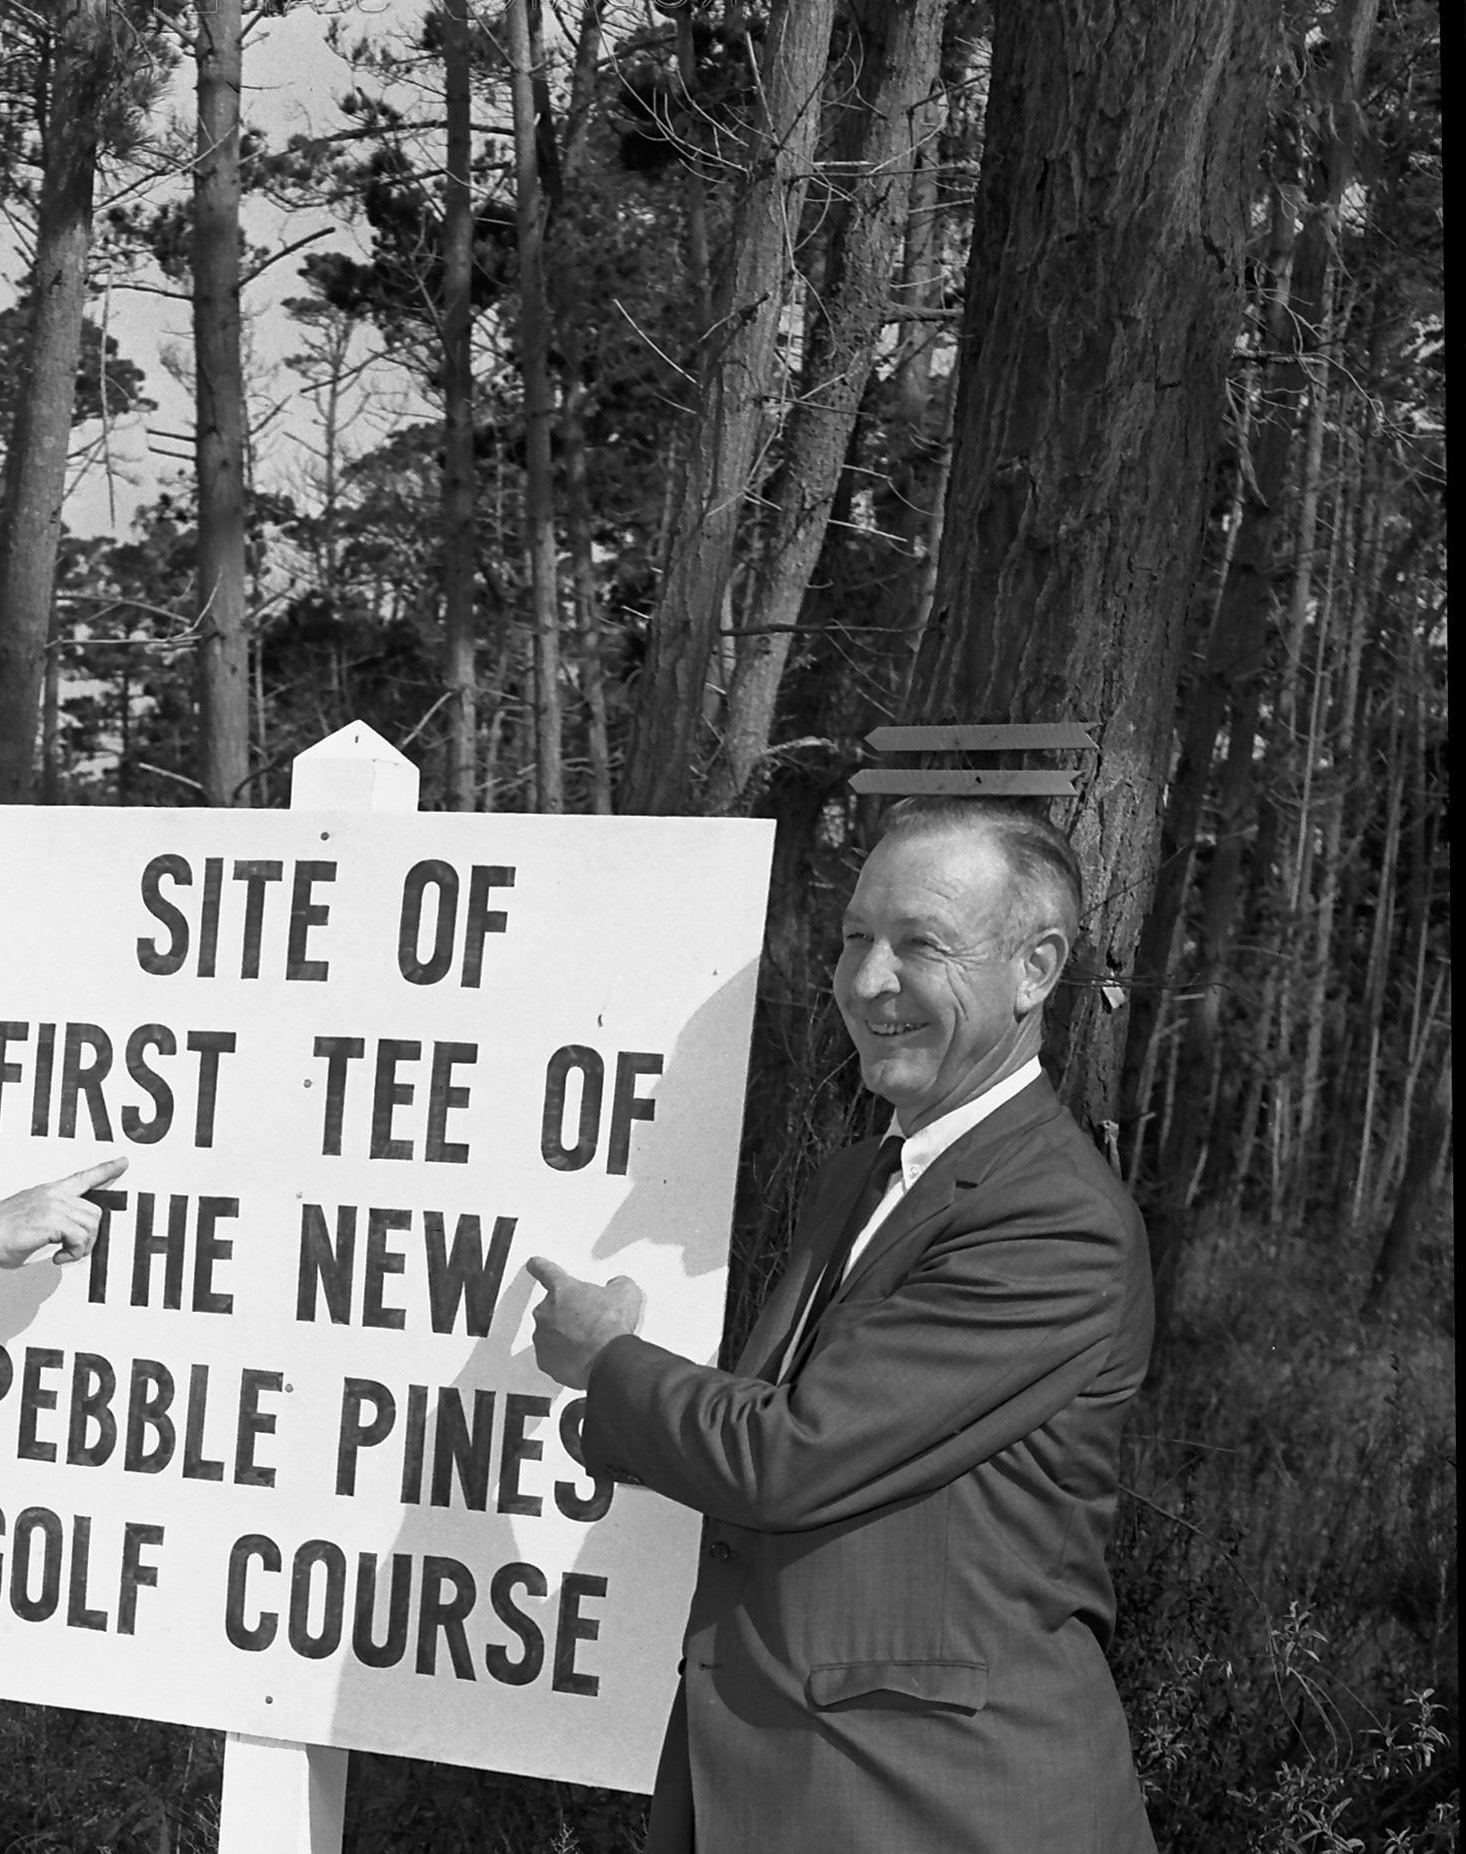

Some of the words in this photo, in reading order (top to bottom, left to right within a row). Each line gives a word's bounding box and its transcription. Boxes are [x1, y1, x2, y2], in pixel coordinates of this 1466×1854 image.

[138, 855, 337, 981] SITE
[399, 860, 515, 988] OF
[314, 1037, 477, 1163] TEE
[542, 1045, 663, 1175] OF
[82, 1188, 238, 1314] THE
[297, 1204, 518, 1337] NEW
[336, 1377, 614, 1522] PINES
[226, 1535, 607, 1696] COURSE
